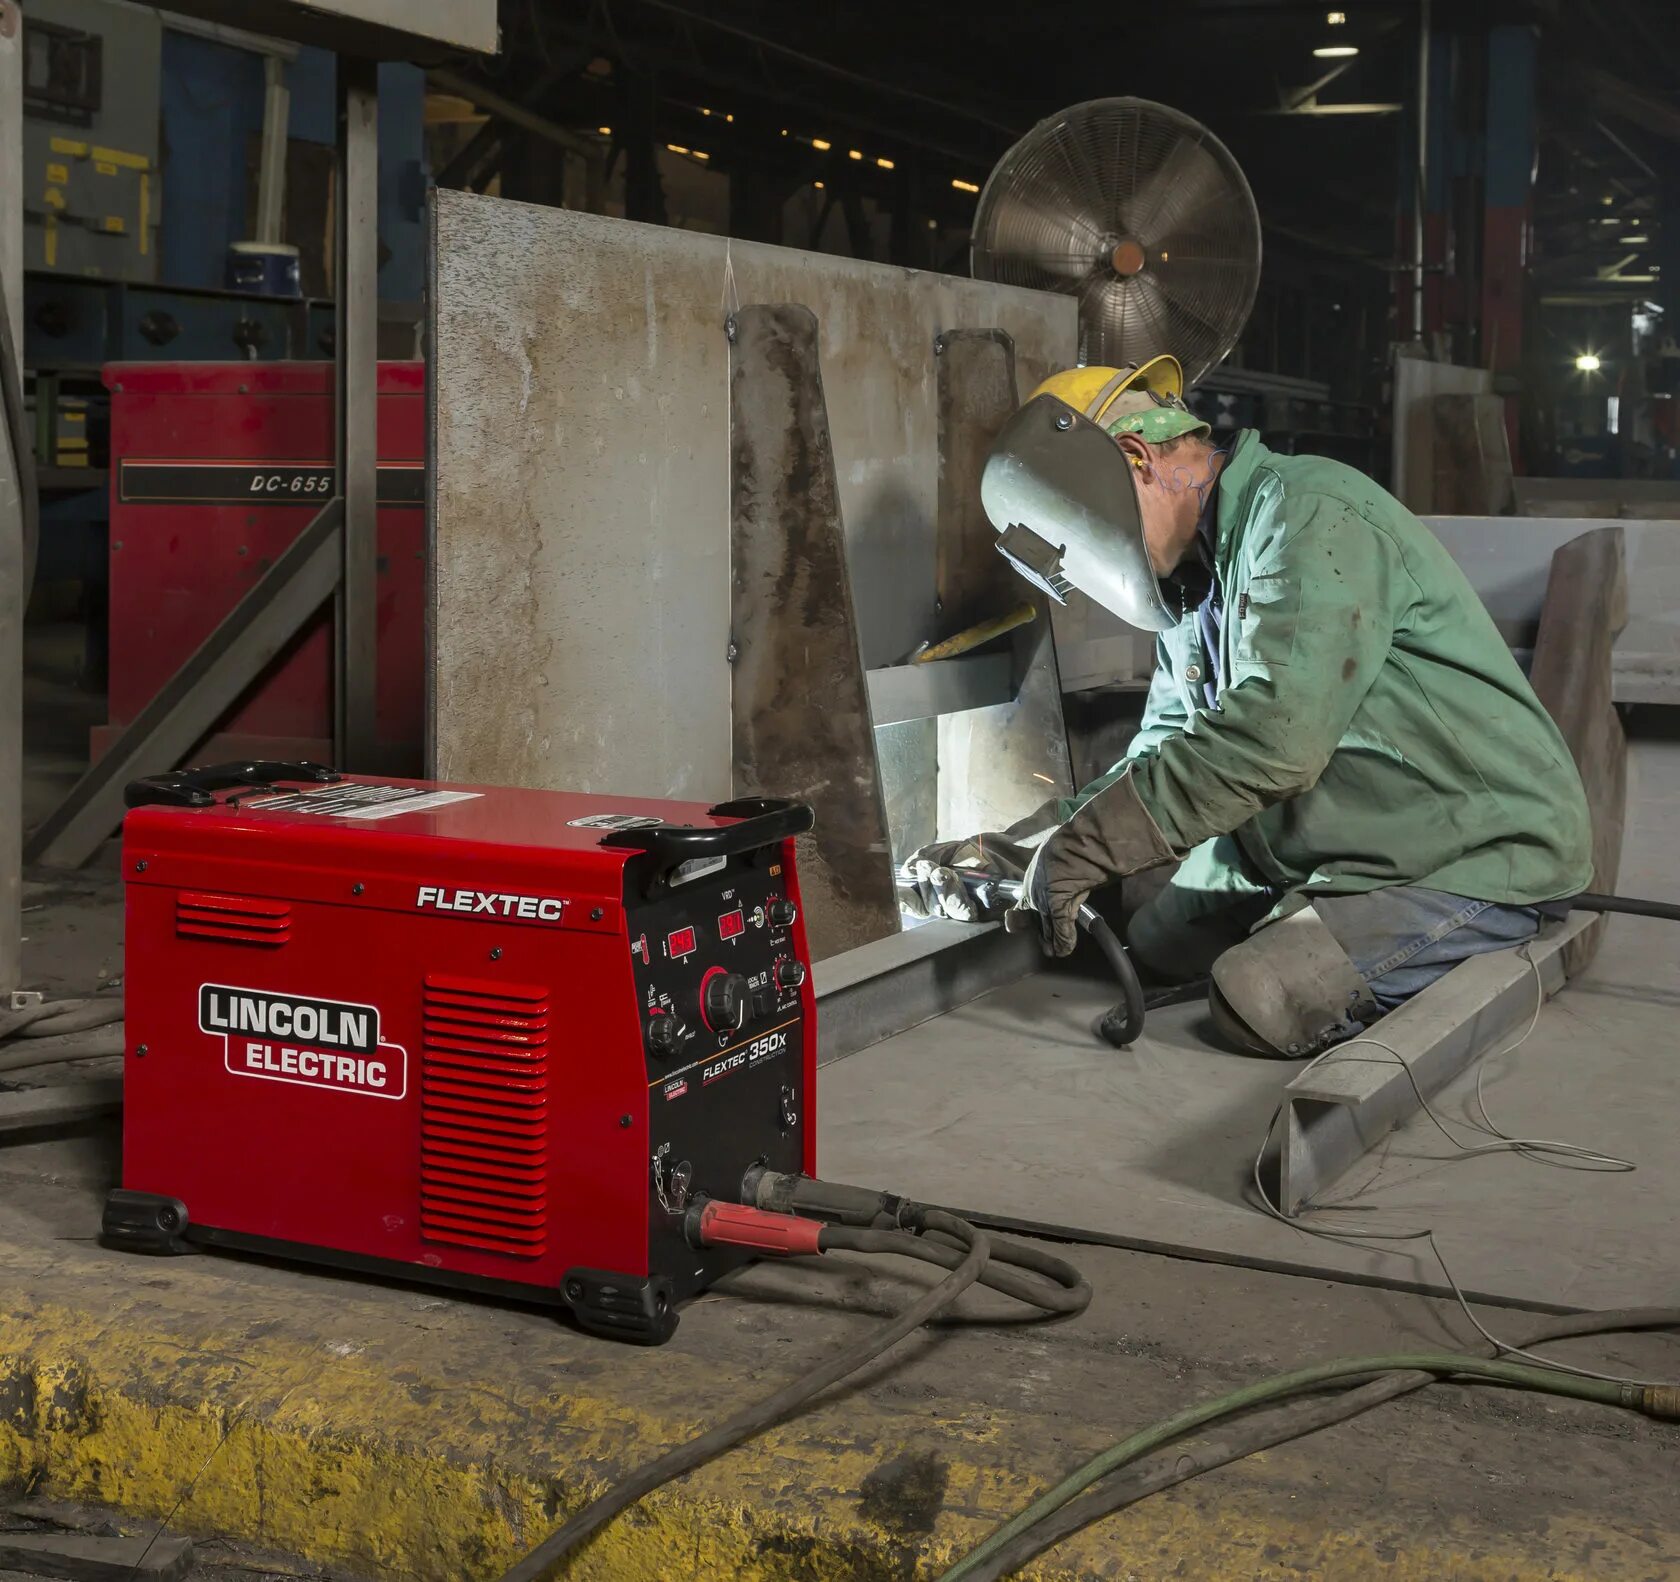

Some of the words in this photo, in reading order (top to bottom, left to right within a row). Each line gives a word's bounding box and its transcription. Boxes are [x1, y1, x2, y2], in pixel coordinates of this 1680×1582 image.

[250, 475, 331, 492] DC-655
[209, 993, 368, 1047] LINCOLN
[246, 1043, 387, 1088] ELECTRIC
[749, 1048, 786, 1068] CONSTRUCTION
[665, 1079, 684, 1093] LINCOLN
